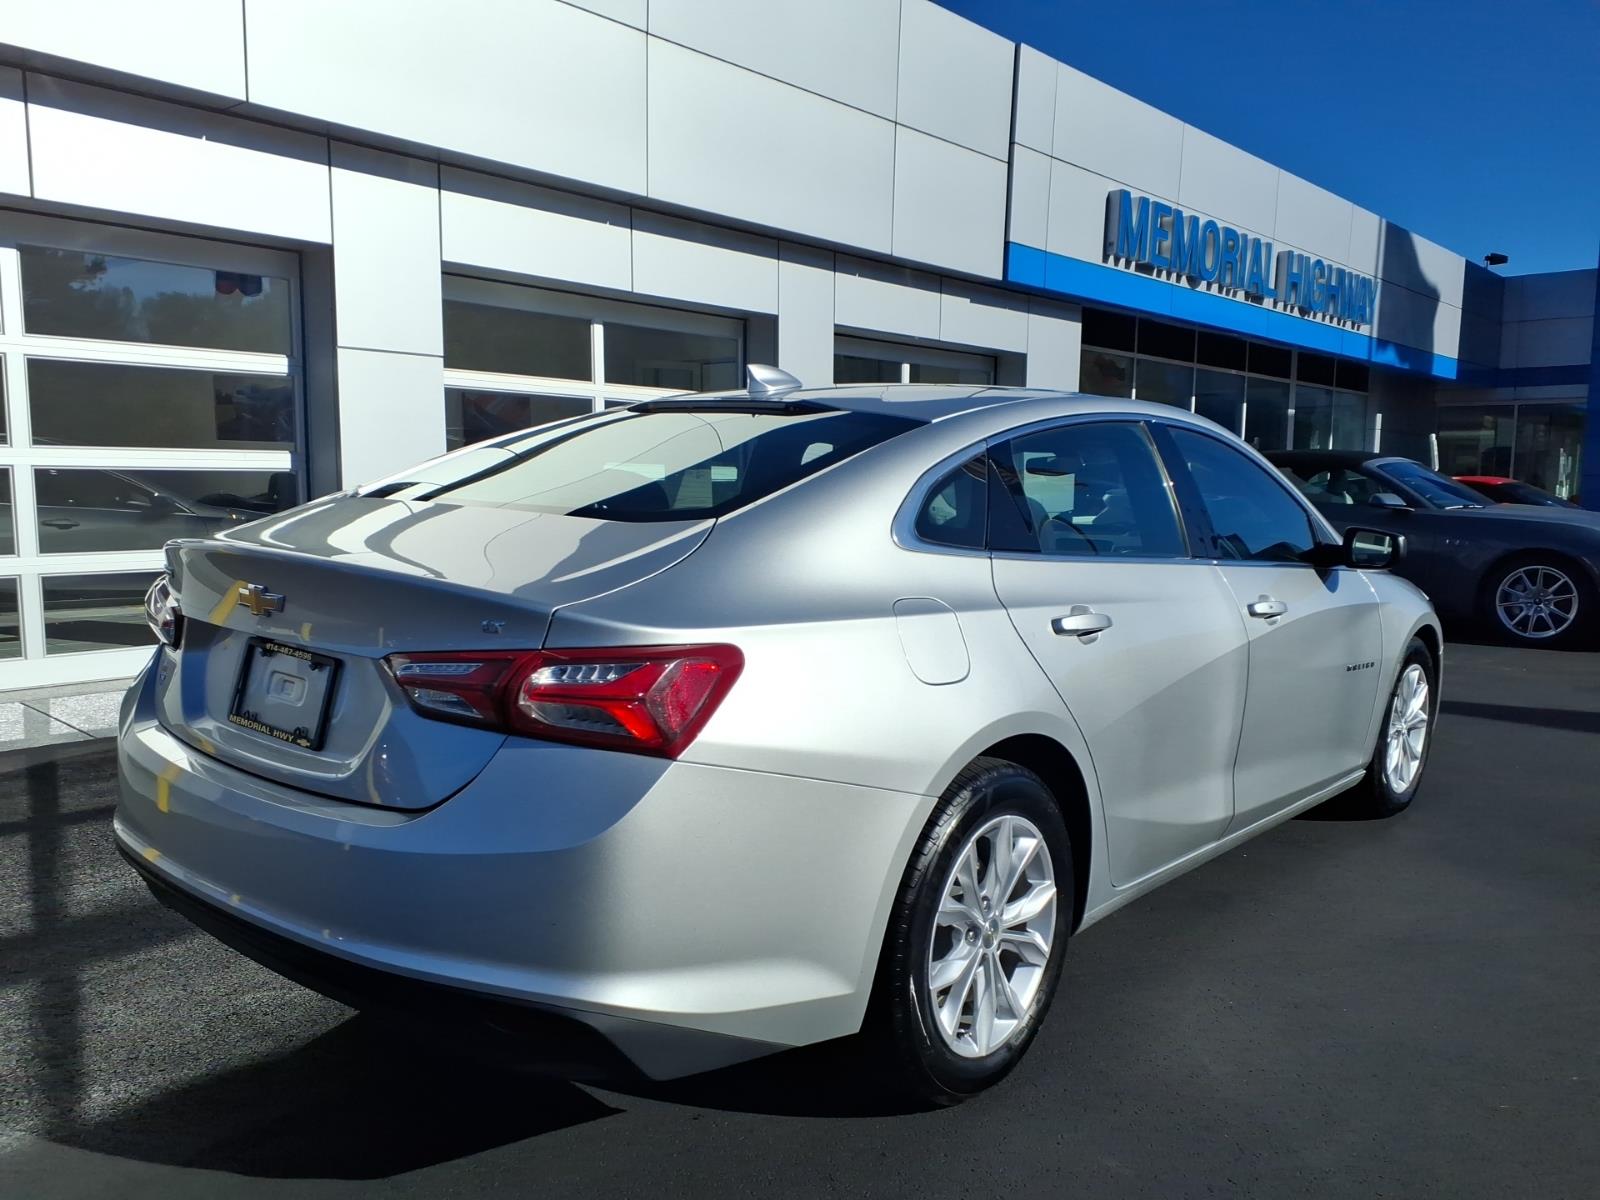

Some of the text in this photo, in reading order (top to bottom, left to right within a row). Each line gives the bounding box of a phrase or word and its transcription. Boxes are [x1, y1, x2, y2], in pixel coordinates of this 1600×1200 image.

[1106, 189, 1379, 324] MEMORIAL HIGHWAY
[229, 714, 294, 742] MEMORIAL HWY
